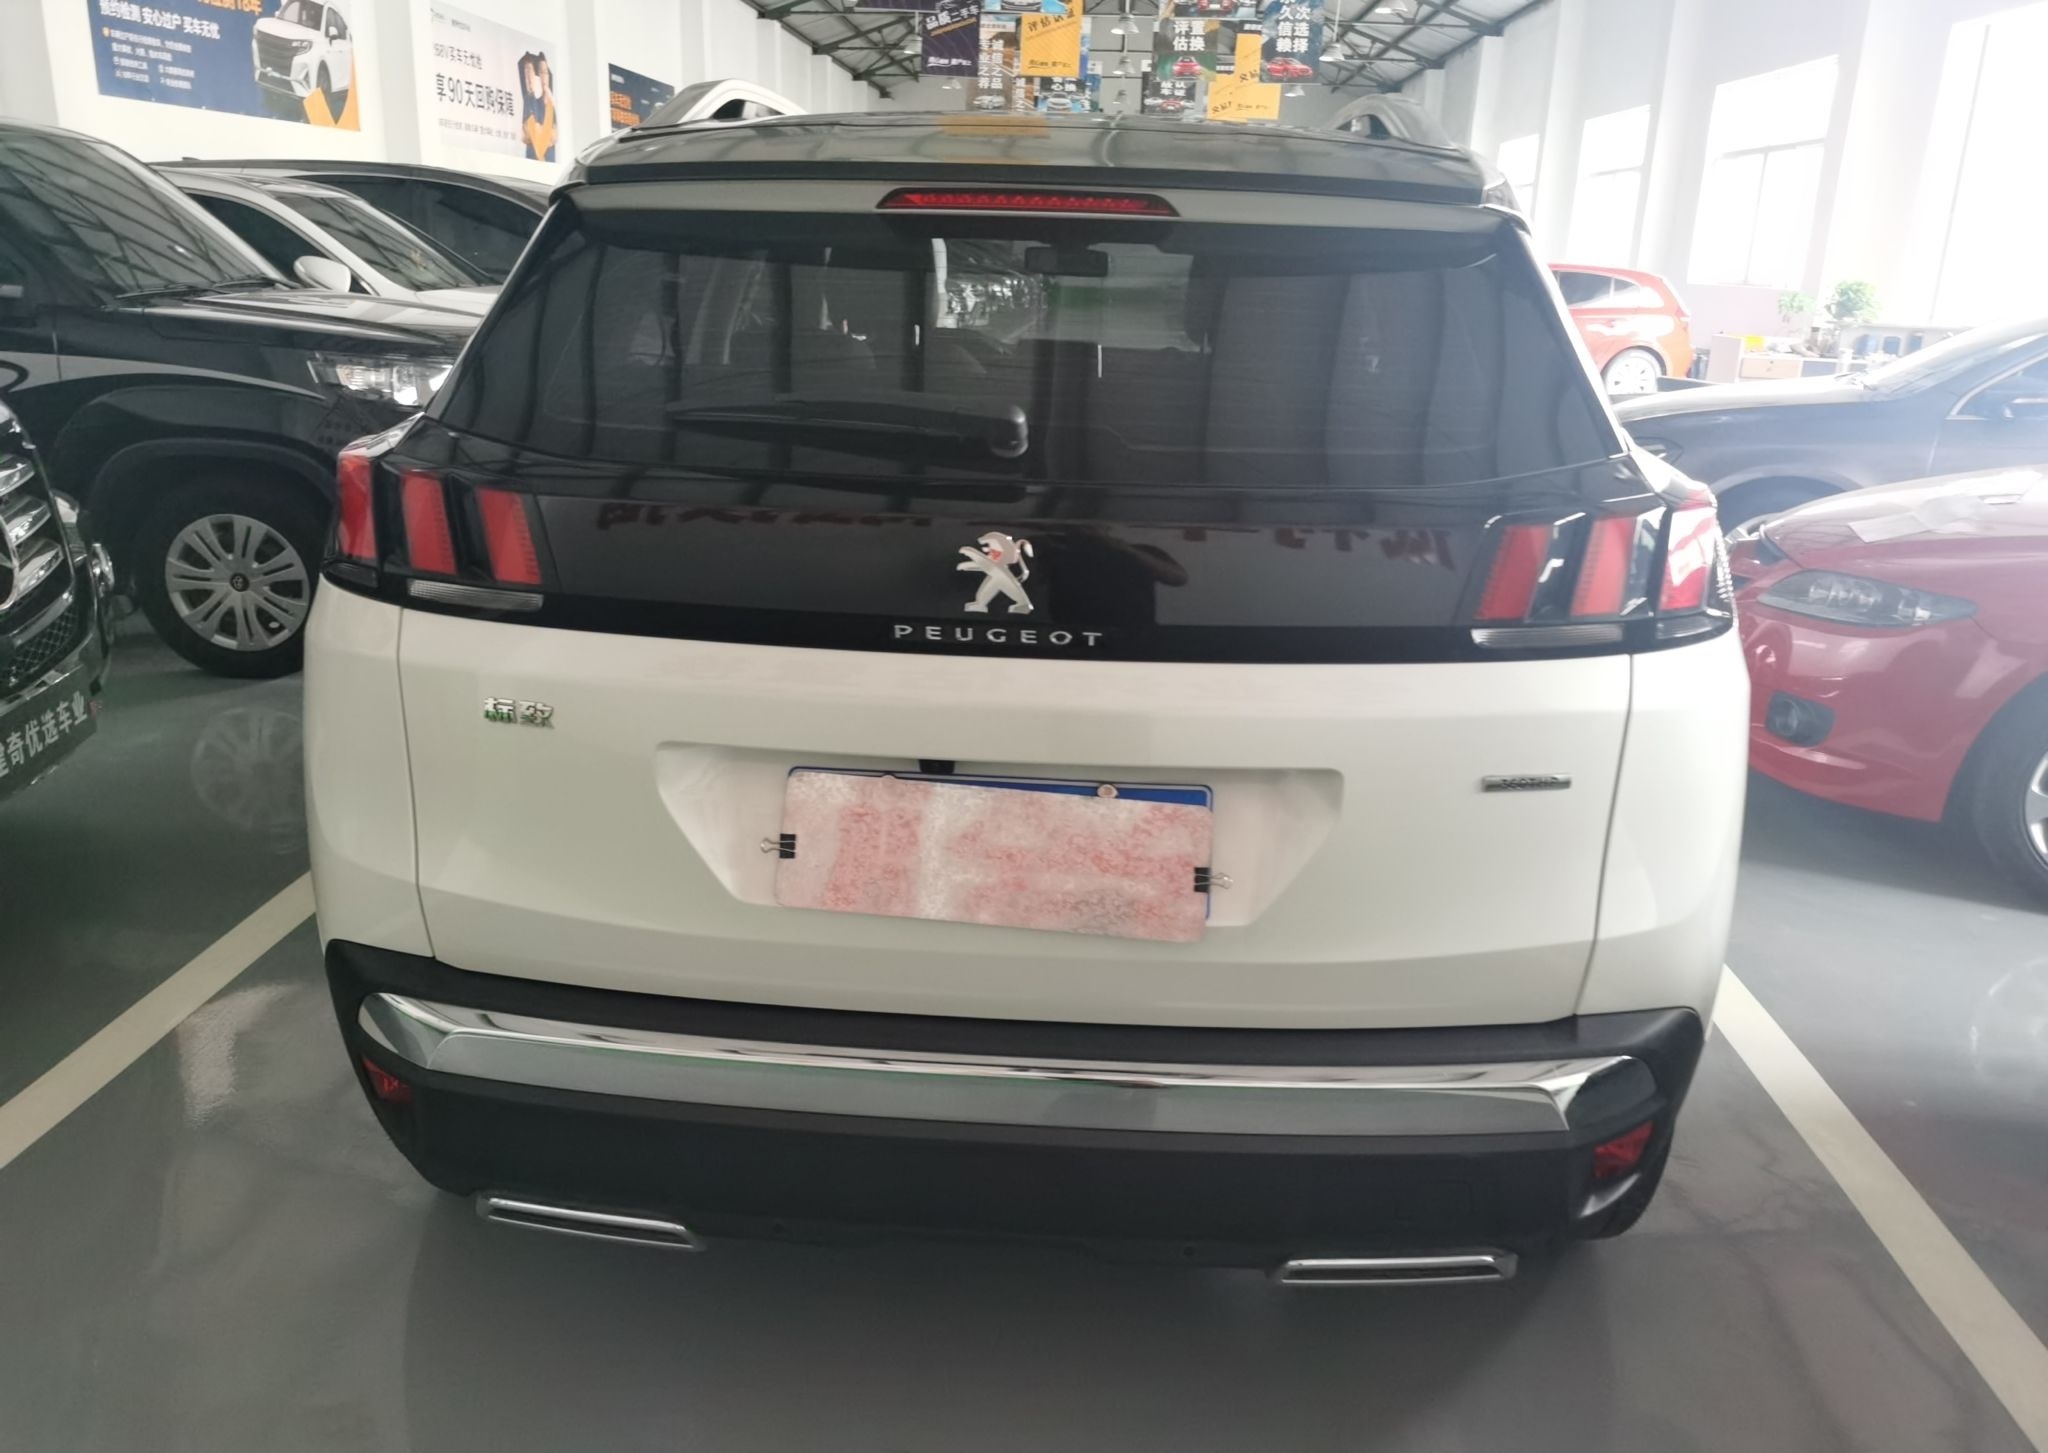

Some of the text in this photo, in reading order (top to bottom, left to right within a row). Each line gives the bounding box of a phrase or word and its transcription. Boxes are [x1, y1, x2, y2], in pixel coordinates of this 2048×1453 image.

[142, 7, 182, 30] 安心过户
[183, 16, 221, 39] 买车无忧
[435, 72, 515, 117] 享90天回购保障
[893, 624, 1103, 647] PEUGEOT
